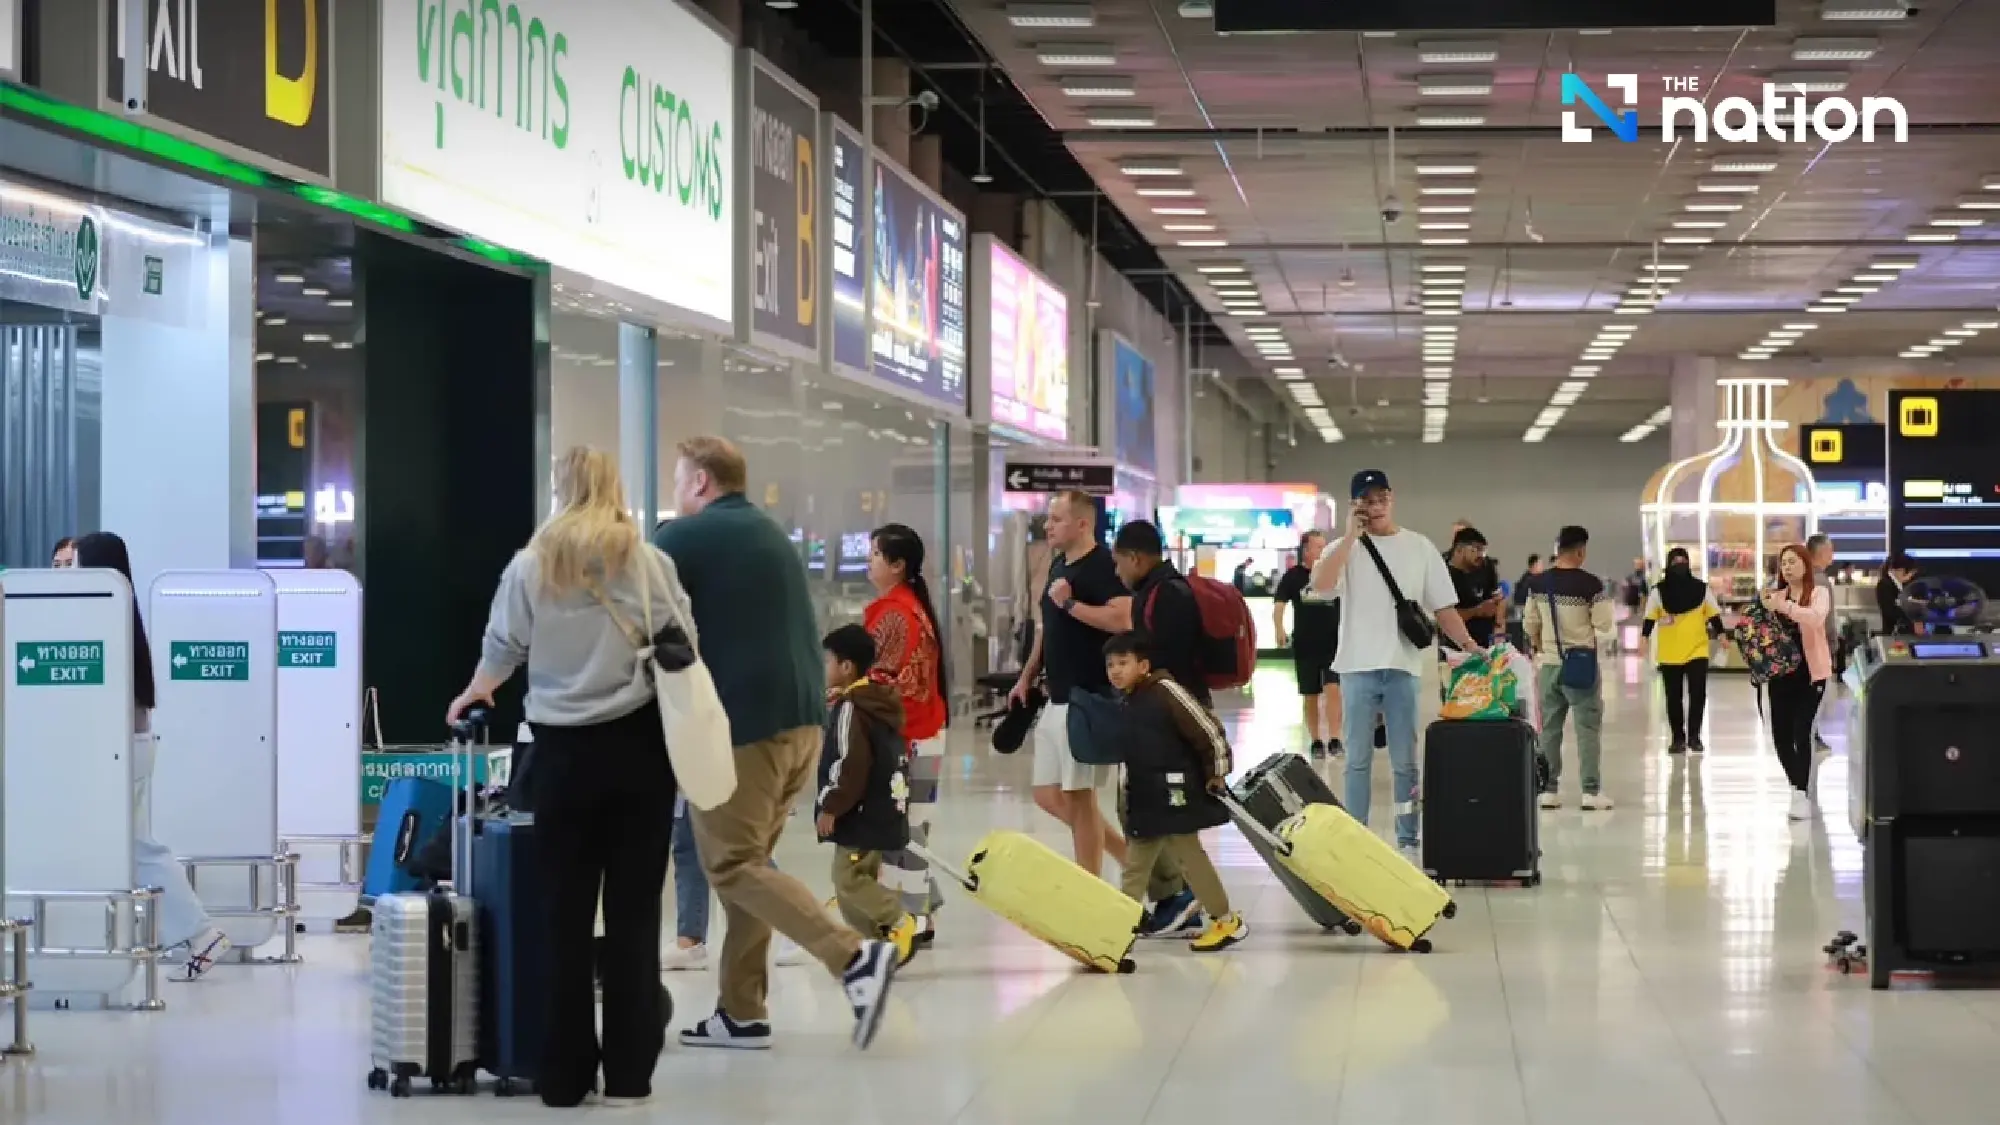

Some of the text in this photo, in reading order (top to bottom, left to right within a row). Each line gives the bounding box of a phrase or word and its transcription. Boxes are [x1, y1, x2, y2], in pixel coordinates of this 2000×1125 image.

[620, 65, 723, 222] CUSTOMS
[797, 134, 813, 326] B
[281, 635, 333, 647] ทางออก
[37, 645, 100, 660] ทางออก
[189, 645, 246, 658] ทางออก
[291, 653, 323, 664] EXIT
[51, 667, 88, 681] EXIT
[201, 665, 235, 677] EXIT
